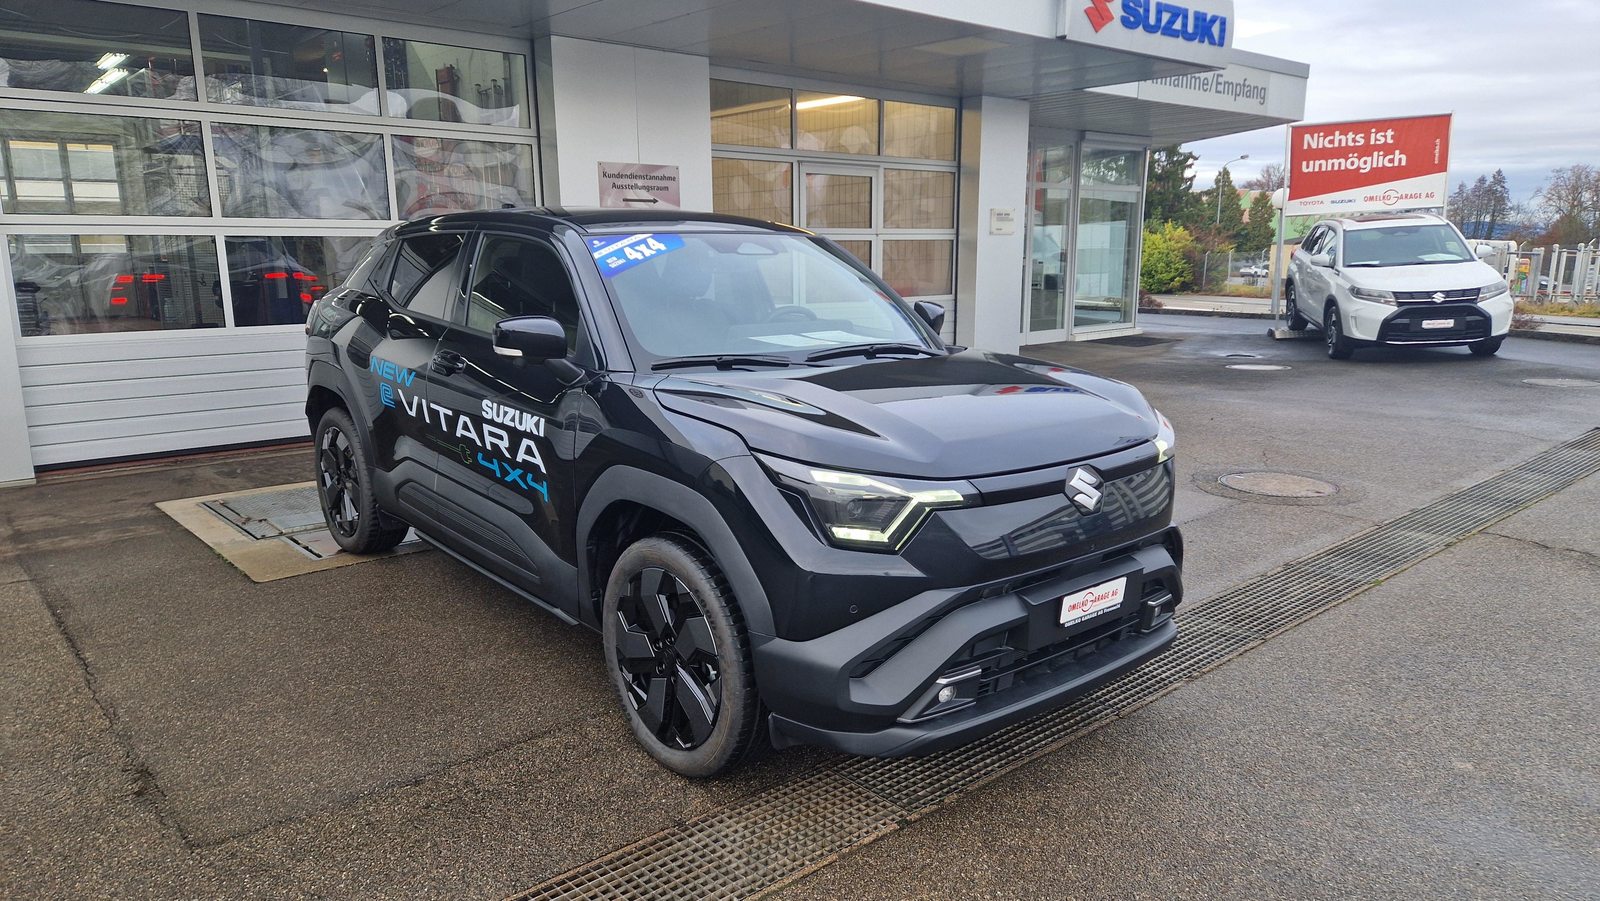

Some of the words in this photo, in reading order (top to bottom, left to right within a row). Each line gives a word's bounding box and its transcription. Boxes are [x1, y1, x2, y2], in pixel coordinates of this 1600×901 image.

[1120, 0, 1227, 47] SUZUKI
[1303, 131, 1365, 149] Nichts
[1370, 128, 1395, 145] ist
[1302, 150, 1407, 173] unmöglich
[602, 171, 677, 182] Kundendienstannahme
[611, 182, 669, 192] Ausstellungsraum
[1363, 194, 1391, 202] OMELKO
[369, 356, 416, 388] NEW
[481, 399, 546, 437] SUZUKI
[398, 388, 547, 474] VITARA
[1067, 599, 1089, 612] OMELKO
[1111, 588, 1119, 598] AG
